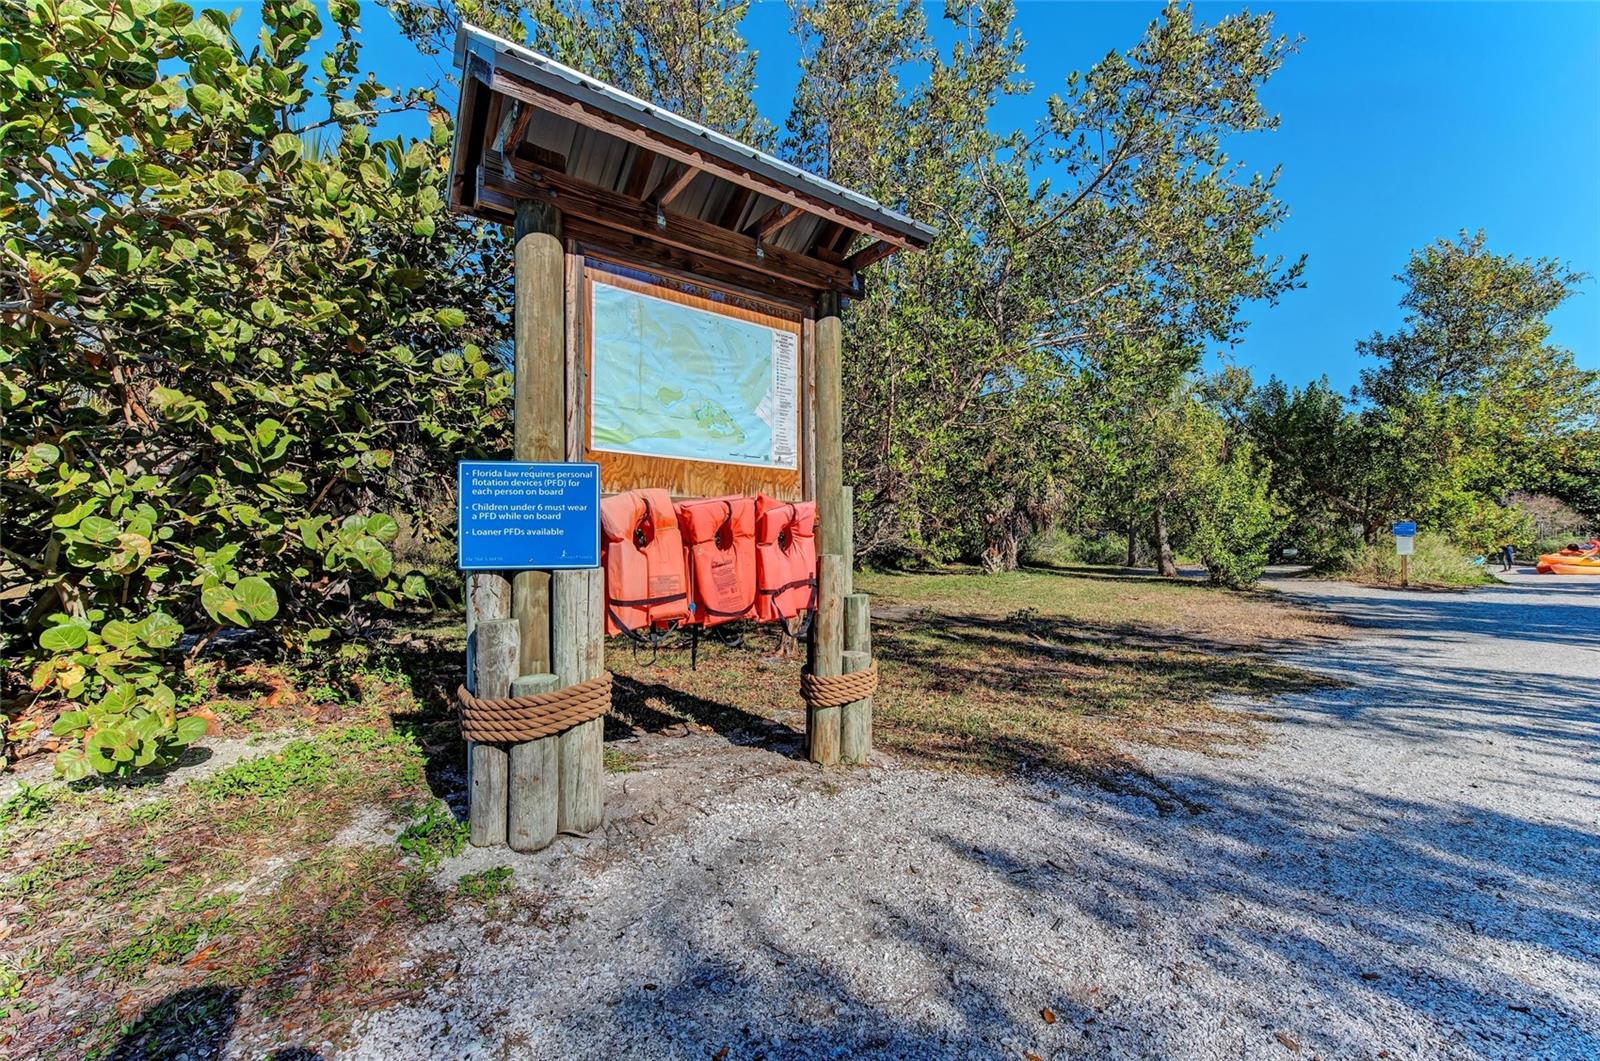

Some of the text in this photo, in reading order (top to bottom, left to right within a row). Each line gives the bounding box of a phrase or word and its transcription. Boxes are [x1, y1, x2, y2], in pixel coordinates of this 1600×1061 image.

[521, 470, 555, 479] requires
[556, 471, 592, 479] personal
[472, 478, 508, 486] flotation
[544, 479, 566, 488] (PFD)
